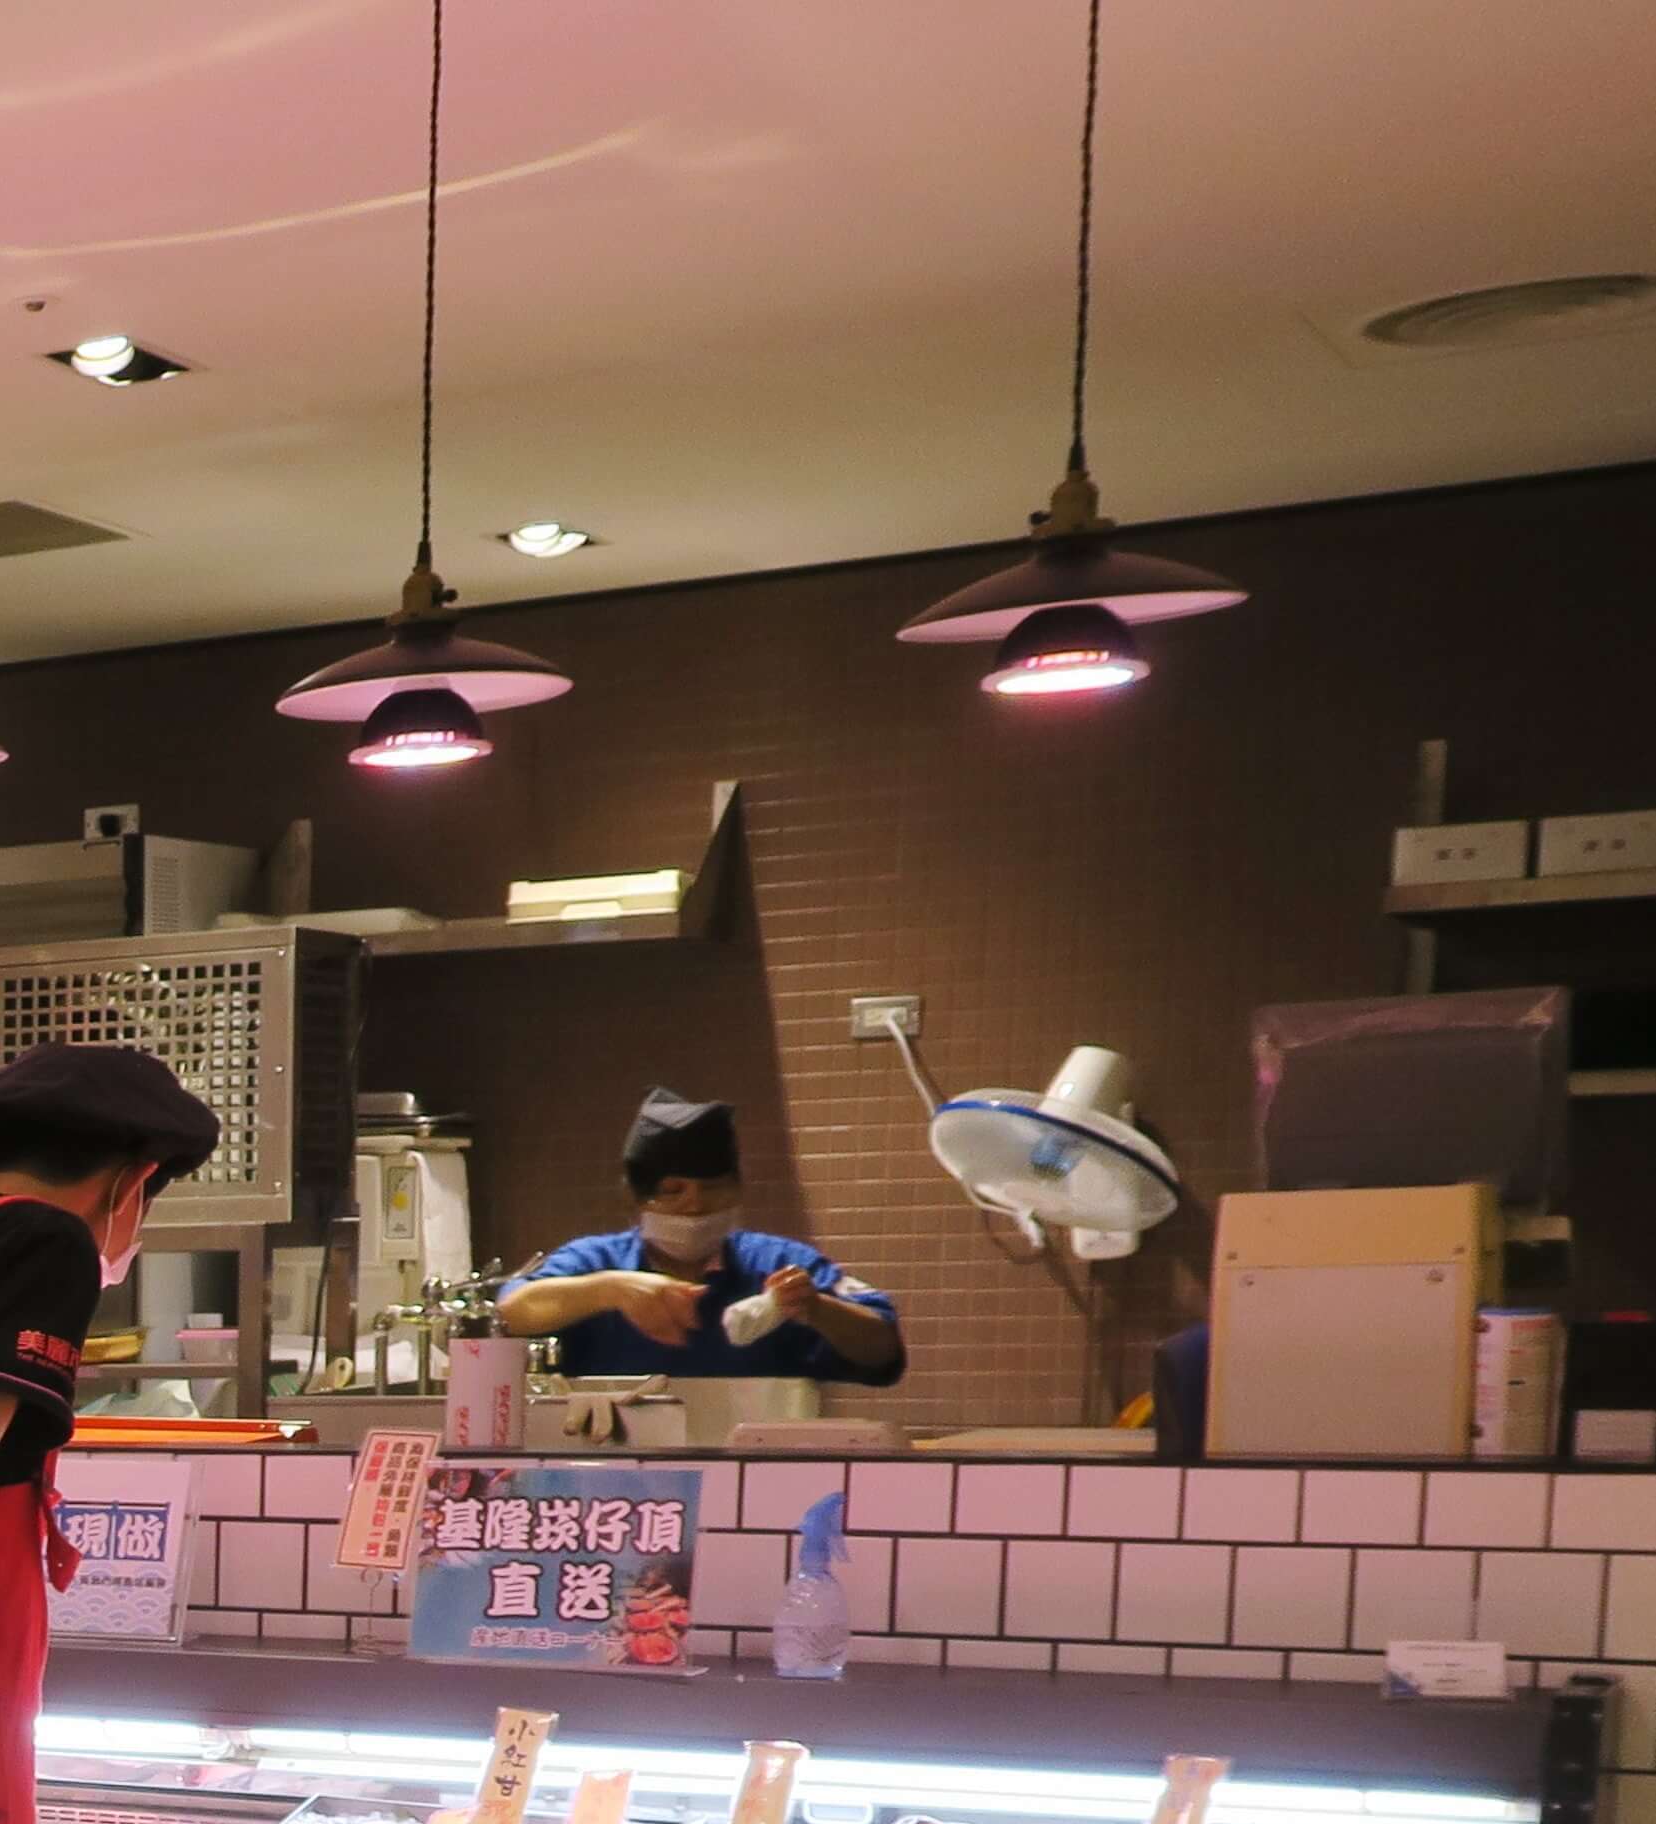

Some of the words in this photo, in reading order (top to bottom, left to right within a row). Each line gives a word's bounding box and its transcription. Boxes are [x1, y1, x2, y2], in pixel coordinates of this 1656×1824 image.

[436, 1499, 685, 1554] 基隆崁仔頂
[486, 1560, 615, 1621] 直送
